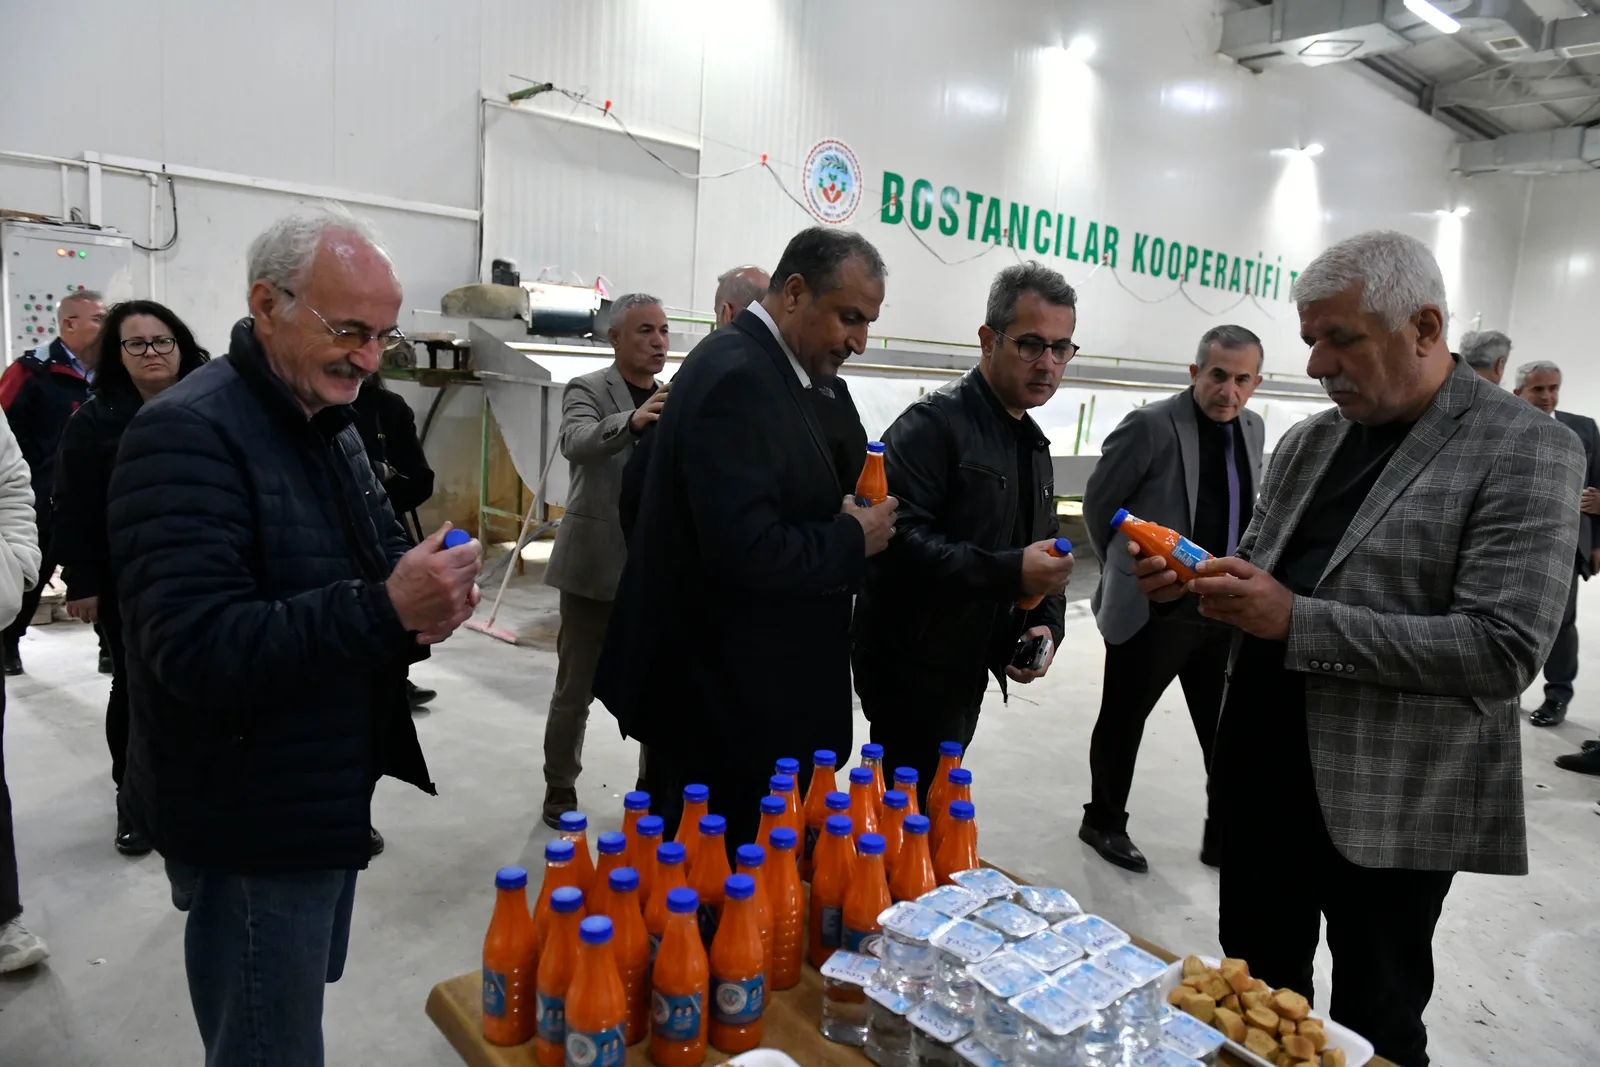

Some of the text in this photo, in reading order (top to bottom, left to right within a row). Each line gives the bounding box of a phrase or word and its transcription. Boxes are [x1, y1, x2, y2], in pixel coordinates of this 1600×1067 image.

[880, 171, 1120, 268] BOSTANCILAR
[1131, 232, 1282, 300] KOOPERATİFİ
[945, 936, 982, 957] Gecek
[829, 967, 865, 982] Gecek
[918, 1013, 952, 1037] Gecek
